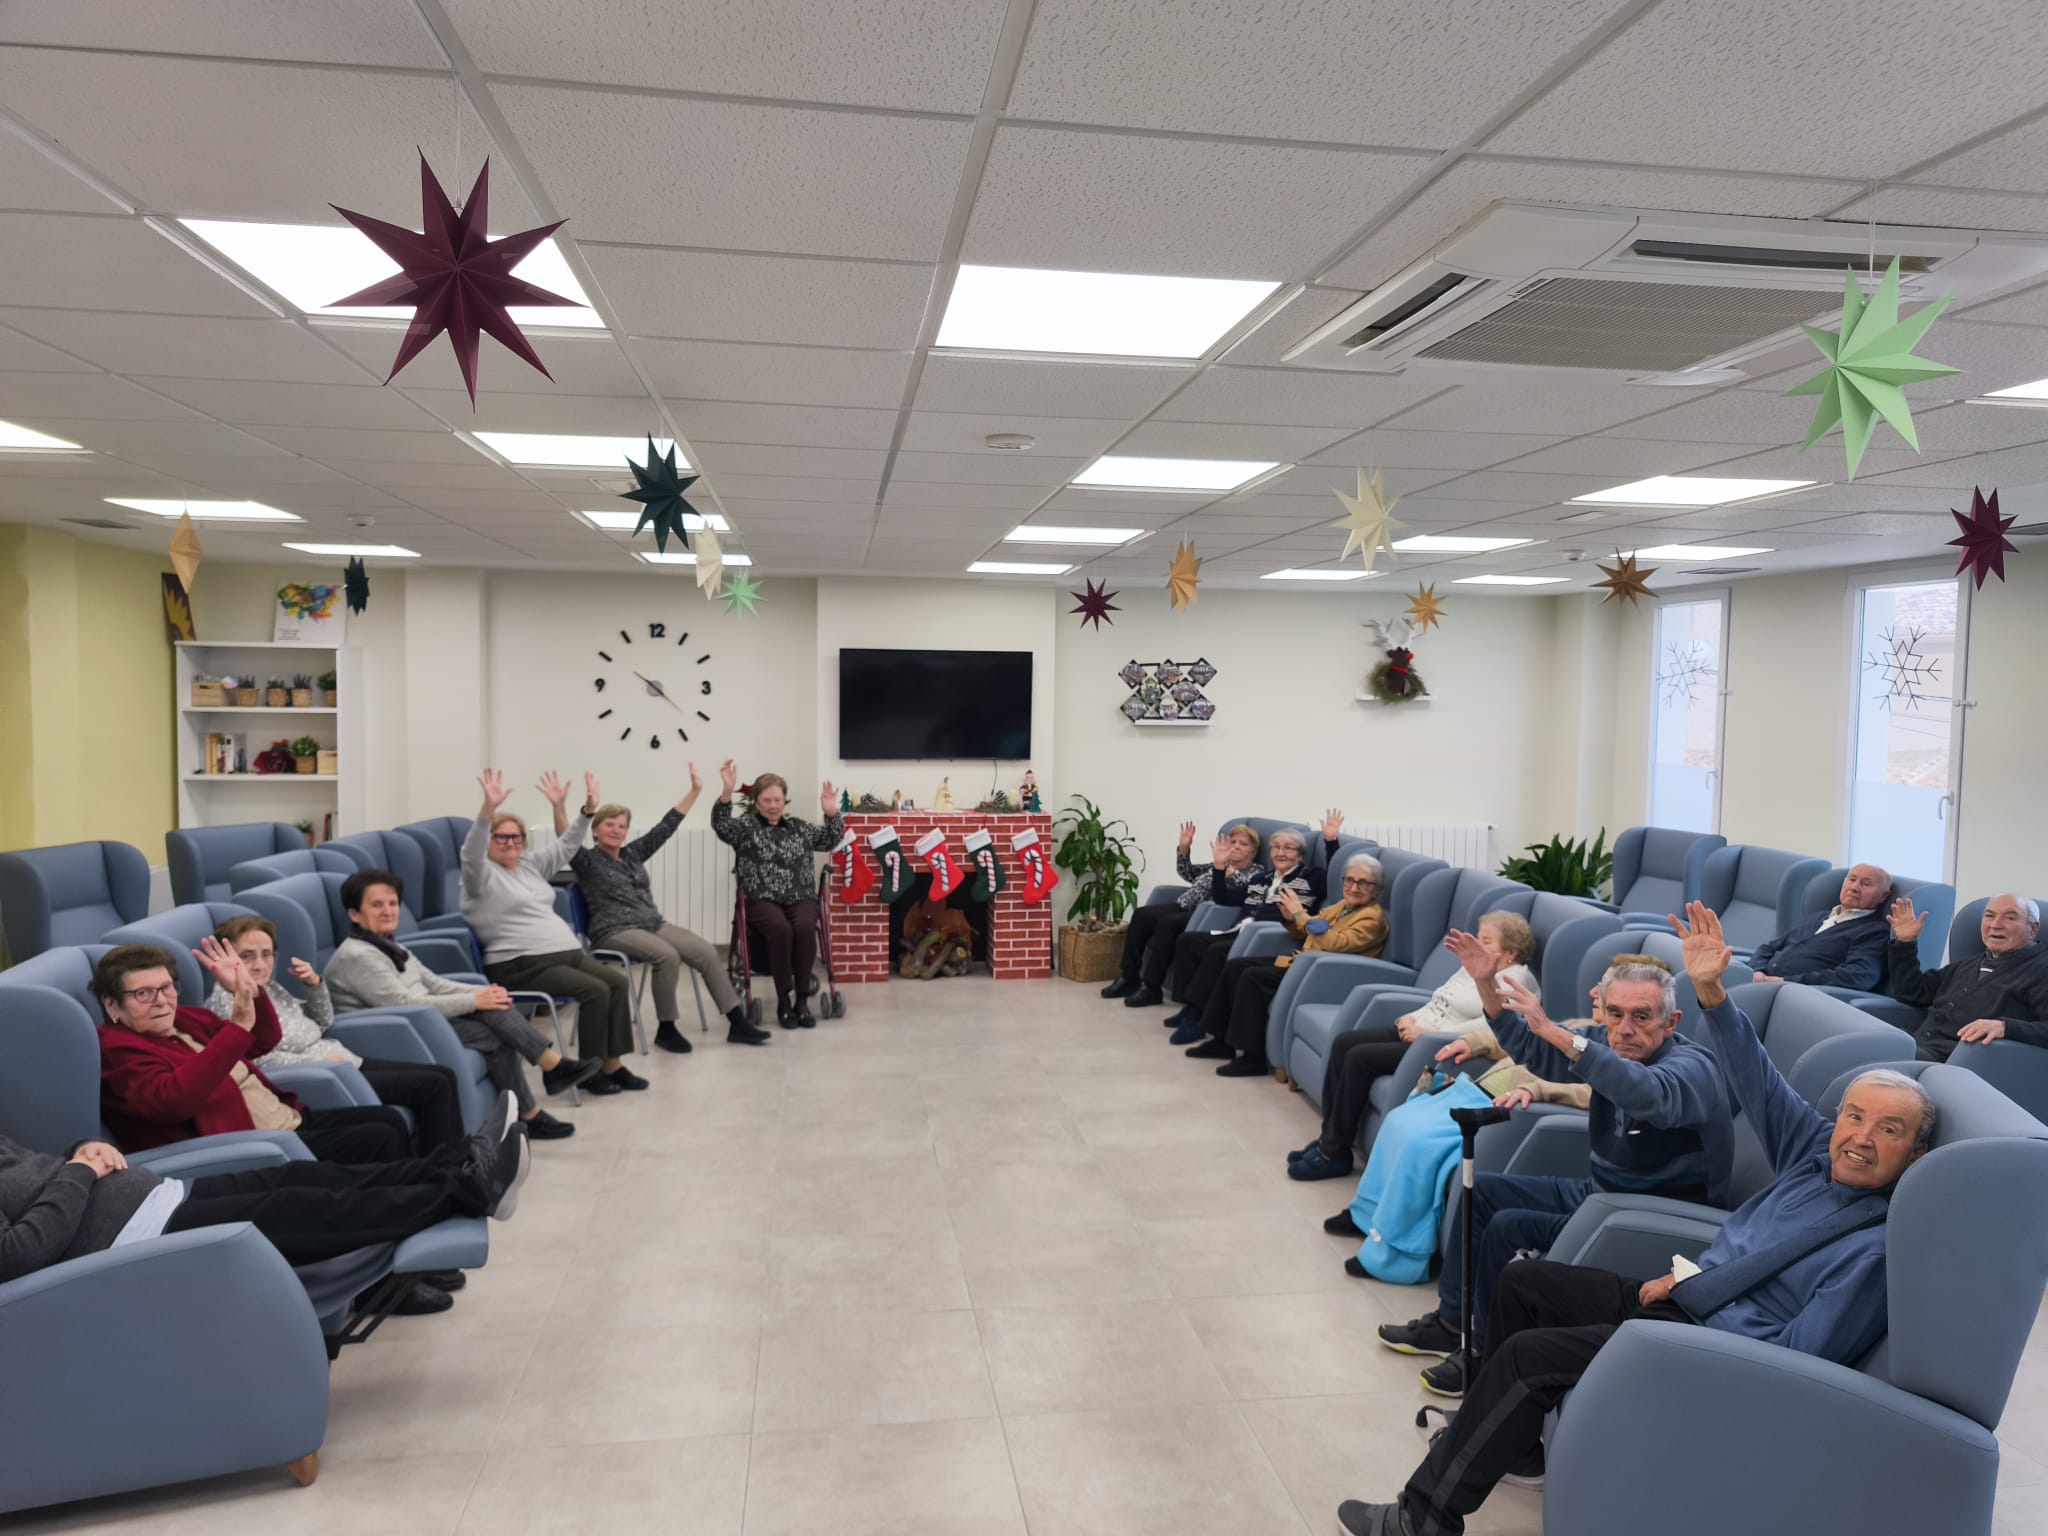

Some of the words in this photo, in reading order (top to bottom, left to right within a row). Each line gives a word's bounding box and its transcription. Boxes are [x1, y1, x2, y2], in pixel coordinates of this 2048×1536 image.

[649, 623, 665, 638] 12
[594, 678, 606, 692] 9
[701, 680, 711, 695] 3
[650, 735, 660, 749] 6
